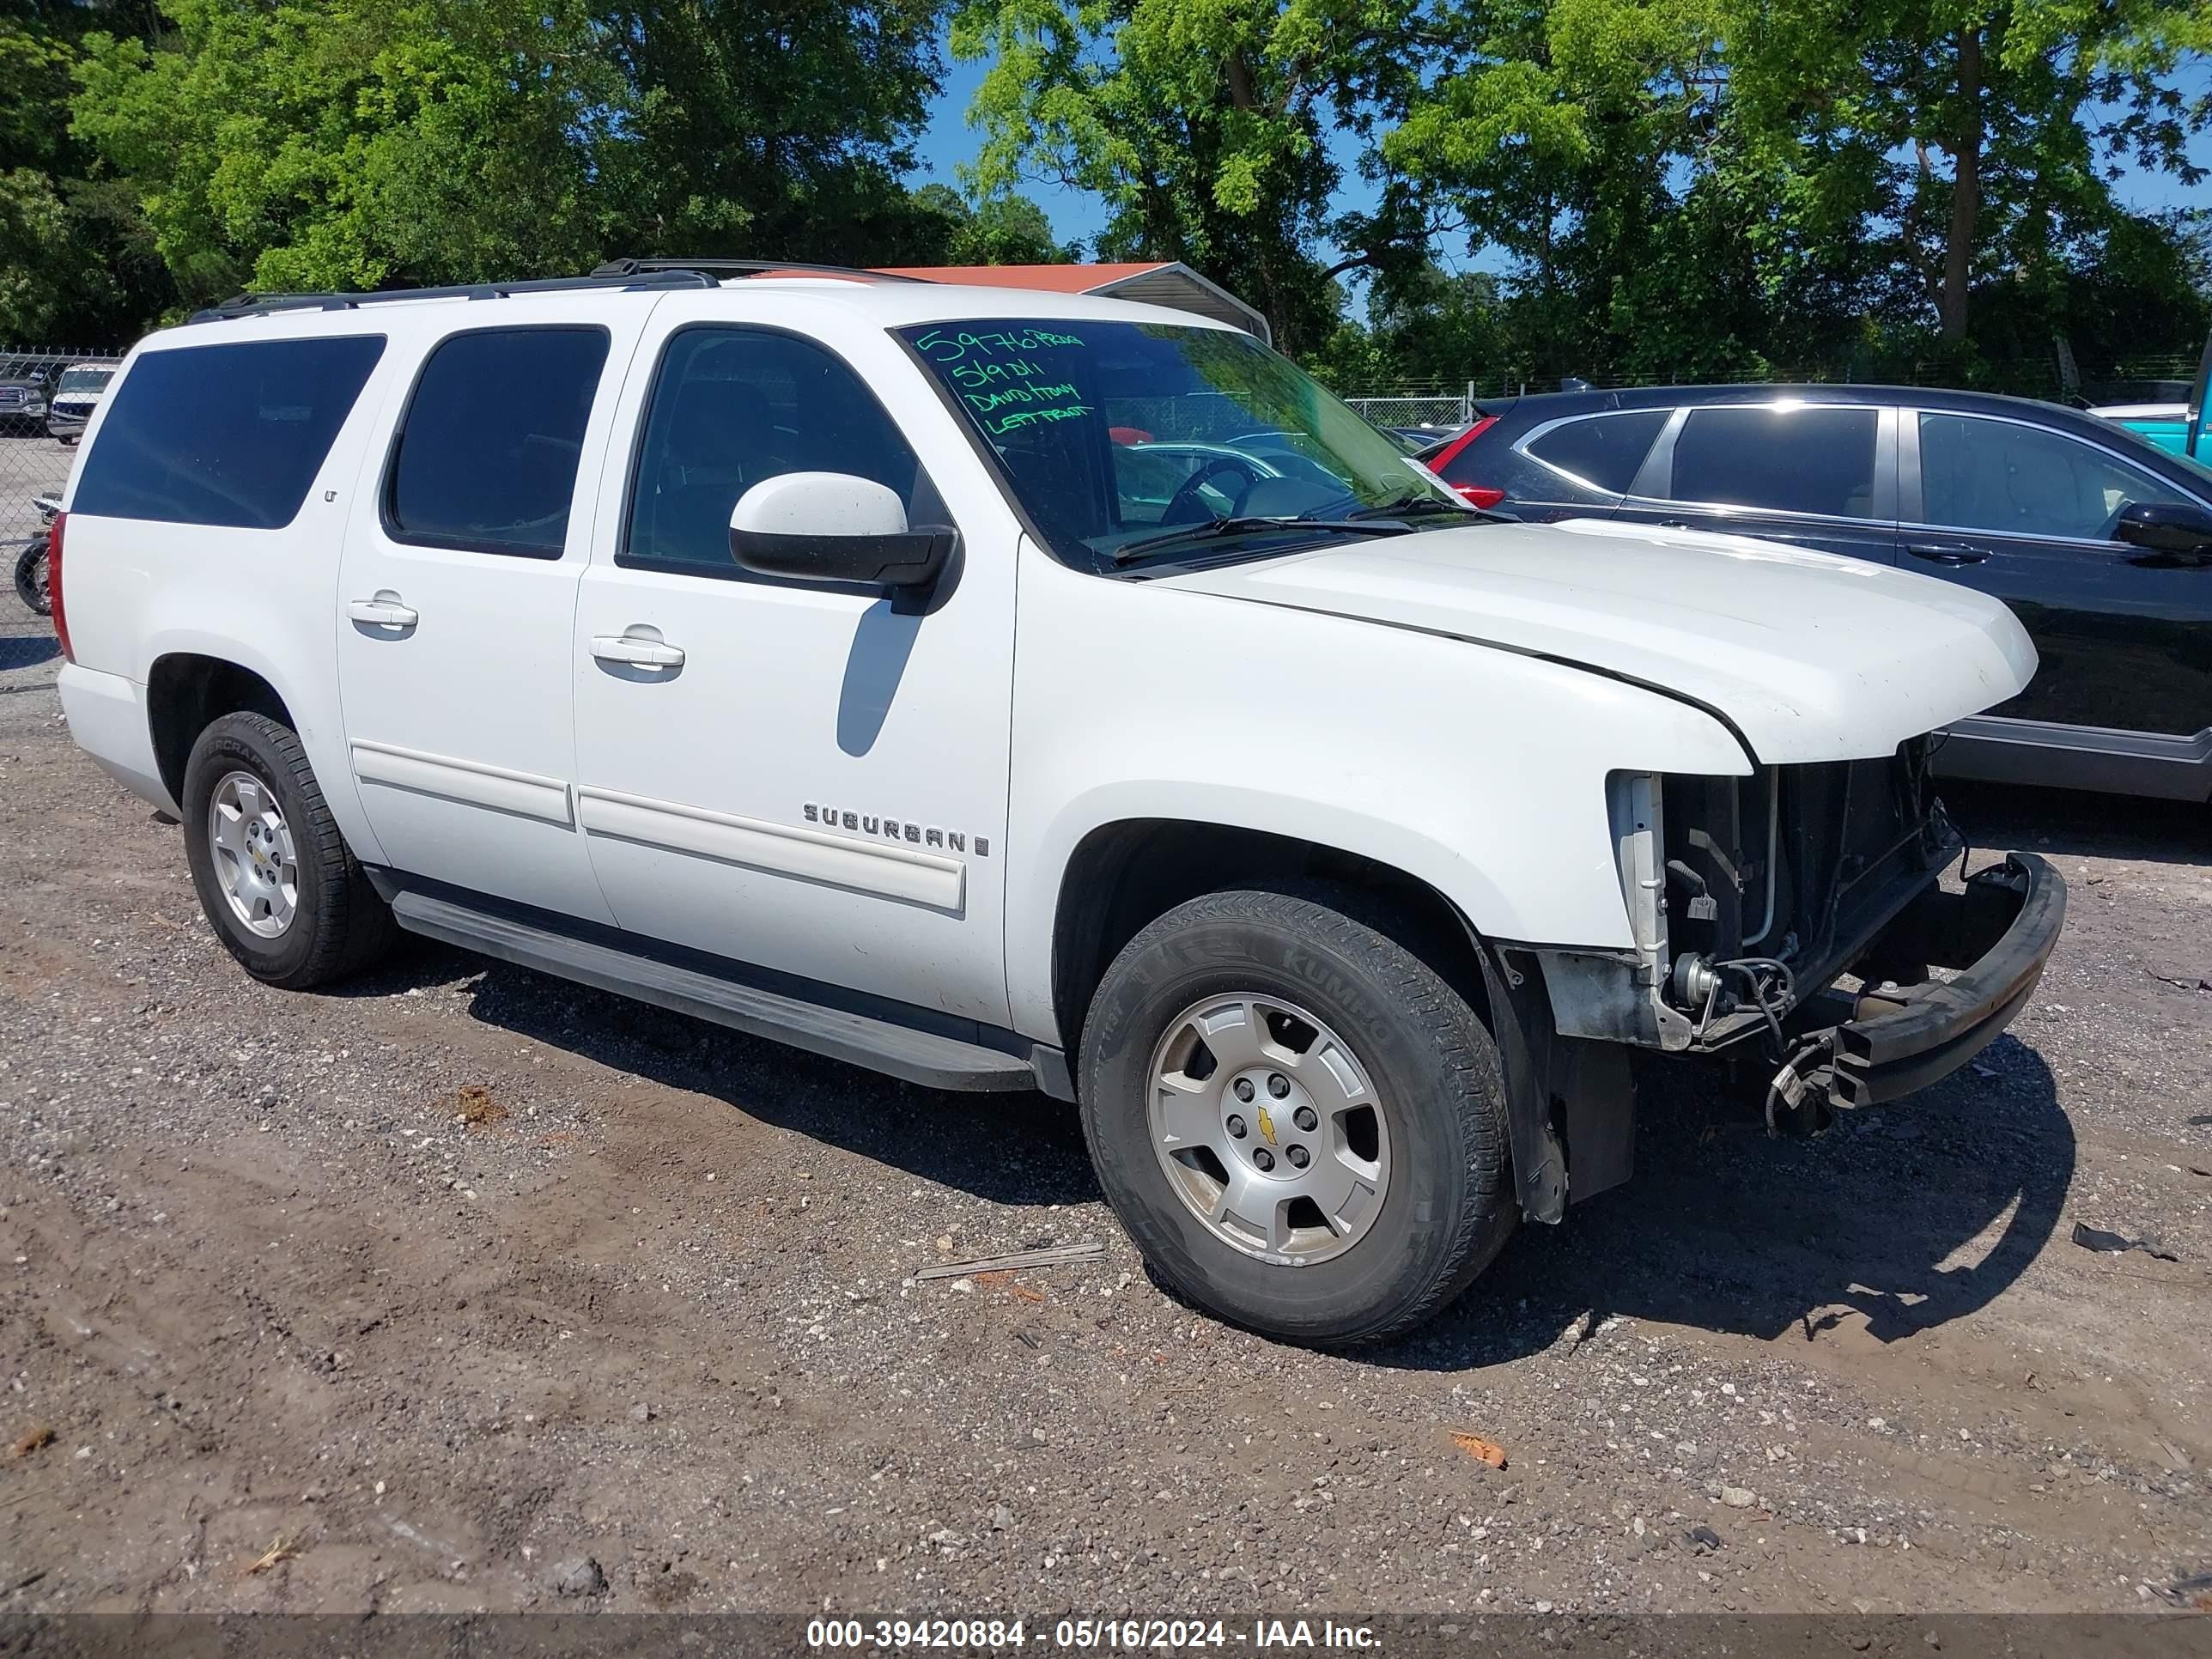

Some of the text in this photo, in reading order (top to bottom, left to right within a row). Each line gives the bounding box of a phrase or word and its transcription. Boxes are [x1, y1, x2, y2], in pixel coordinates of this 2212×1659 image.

[916, 331, 1038, 362] 5976
[985, 405, 1096, 434] LEFT FRONT
[324, 489, 338, 503] LT
[803, 802, 966, 853] SUBURBAN
[1281, 946, 1391, 1043] KUMHO
